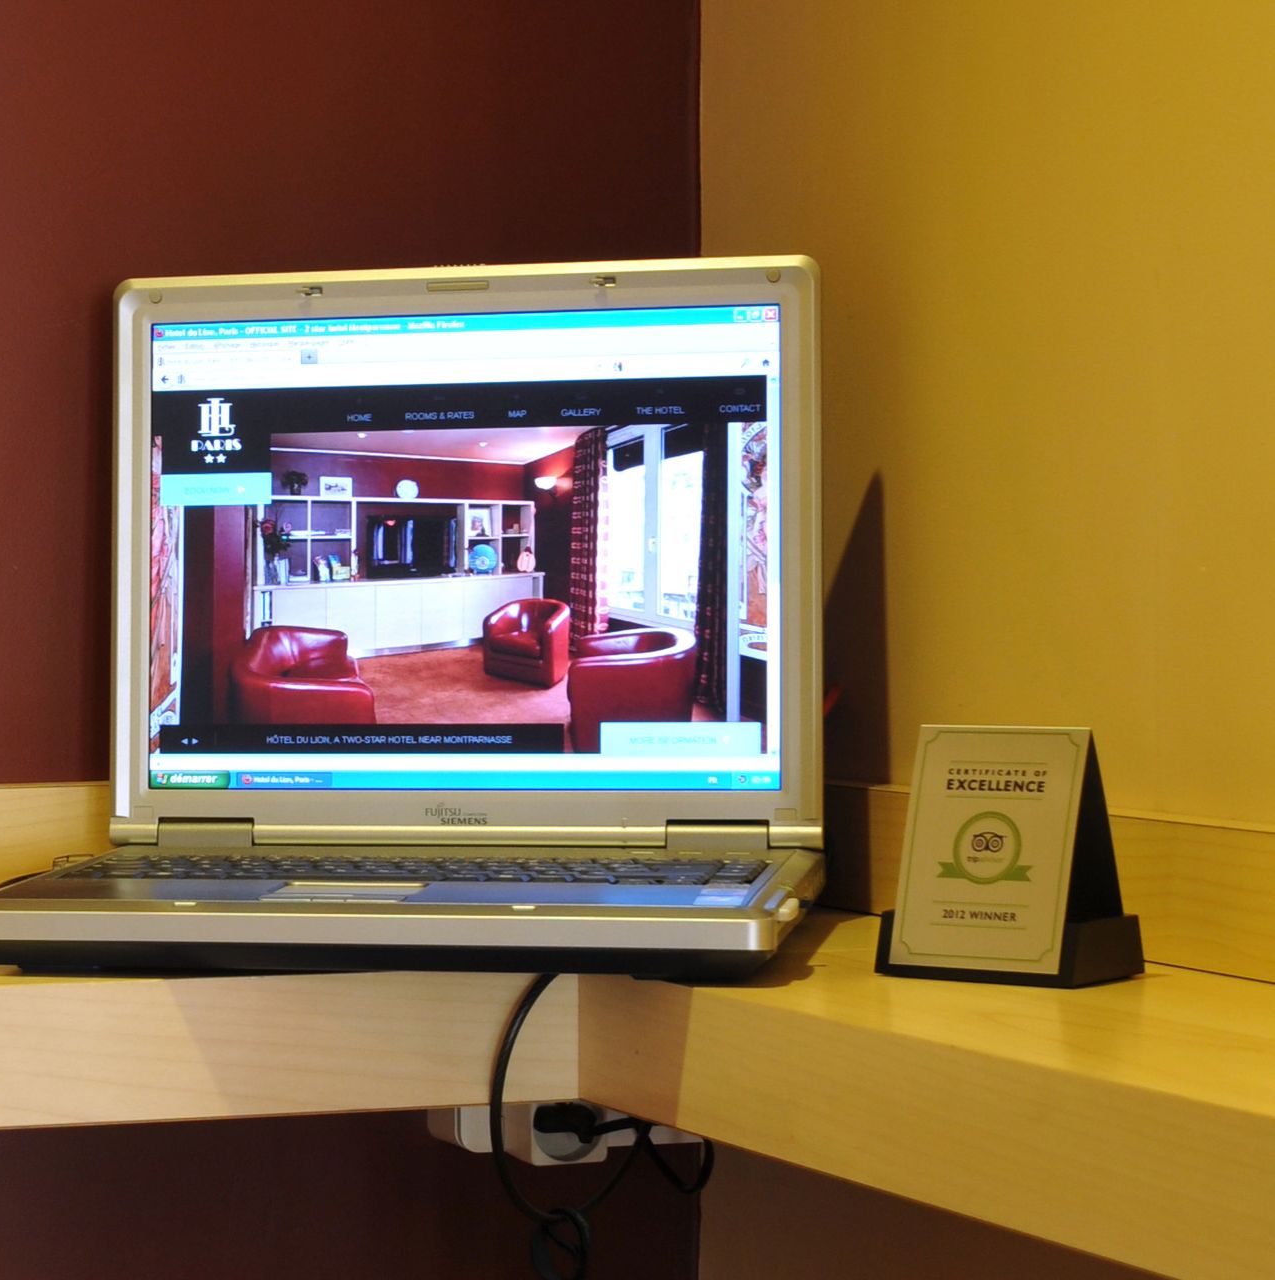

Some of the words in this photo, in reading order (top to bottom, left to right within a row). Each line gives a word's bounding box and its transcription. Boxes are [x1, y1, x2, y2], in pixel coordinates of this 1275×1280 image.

[560, 408, 602, 417] GALLERY
[636, 406, 654, 415] THE
[655, 406, 685, 415] HOTEL
[719, 404, 761, 413] CONTACT
[347, 413, 372, 422] HOME
[405, 412, 437, 421] ROOMS
[439, 412, 446, 420] &
[447, 411, 475, 420] RATES
[508, 410, 527, 418] MAP
[191, 438, 242, 452] PARIS
[266, 734, 294, 744] HÔTEL
[297, 735, 309, 744] DU
[333, 736, 341, 744] A
[342, 736, 387, 744] TWO-STAR
[388, 736, 417, 744] HOTEL
[418, 736, 442, 744] NEAR
[443, 735, 512, 744] MONTPARNASSE
[948, 768, 1026, 777] CERTIFICATE
[170, 773, 219, 784] démarrer
[946, 778, 1045, 793] EXCELLENCE
[425, 805, 461, 818] FUJITSU
[440, 817, 488, 825] SIEMENS
[942, 908, 966, 919] 2012
[969, 910, 1017, 921] WINNER
